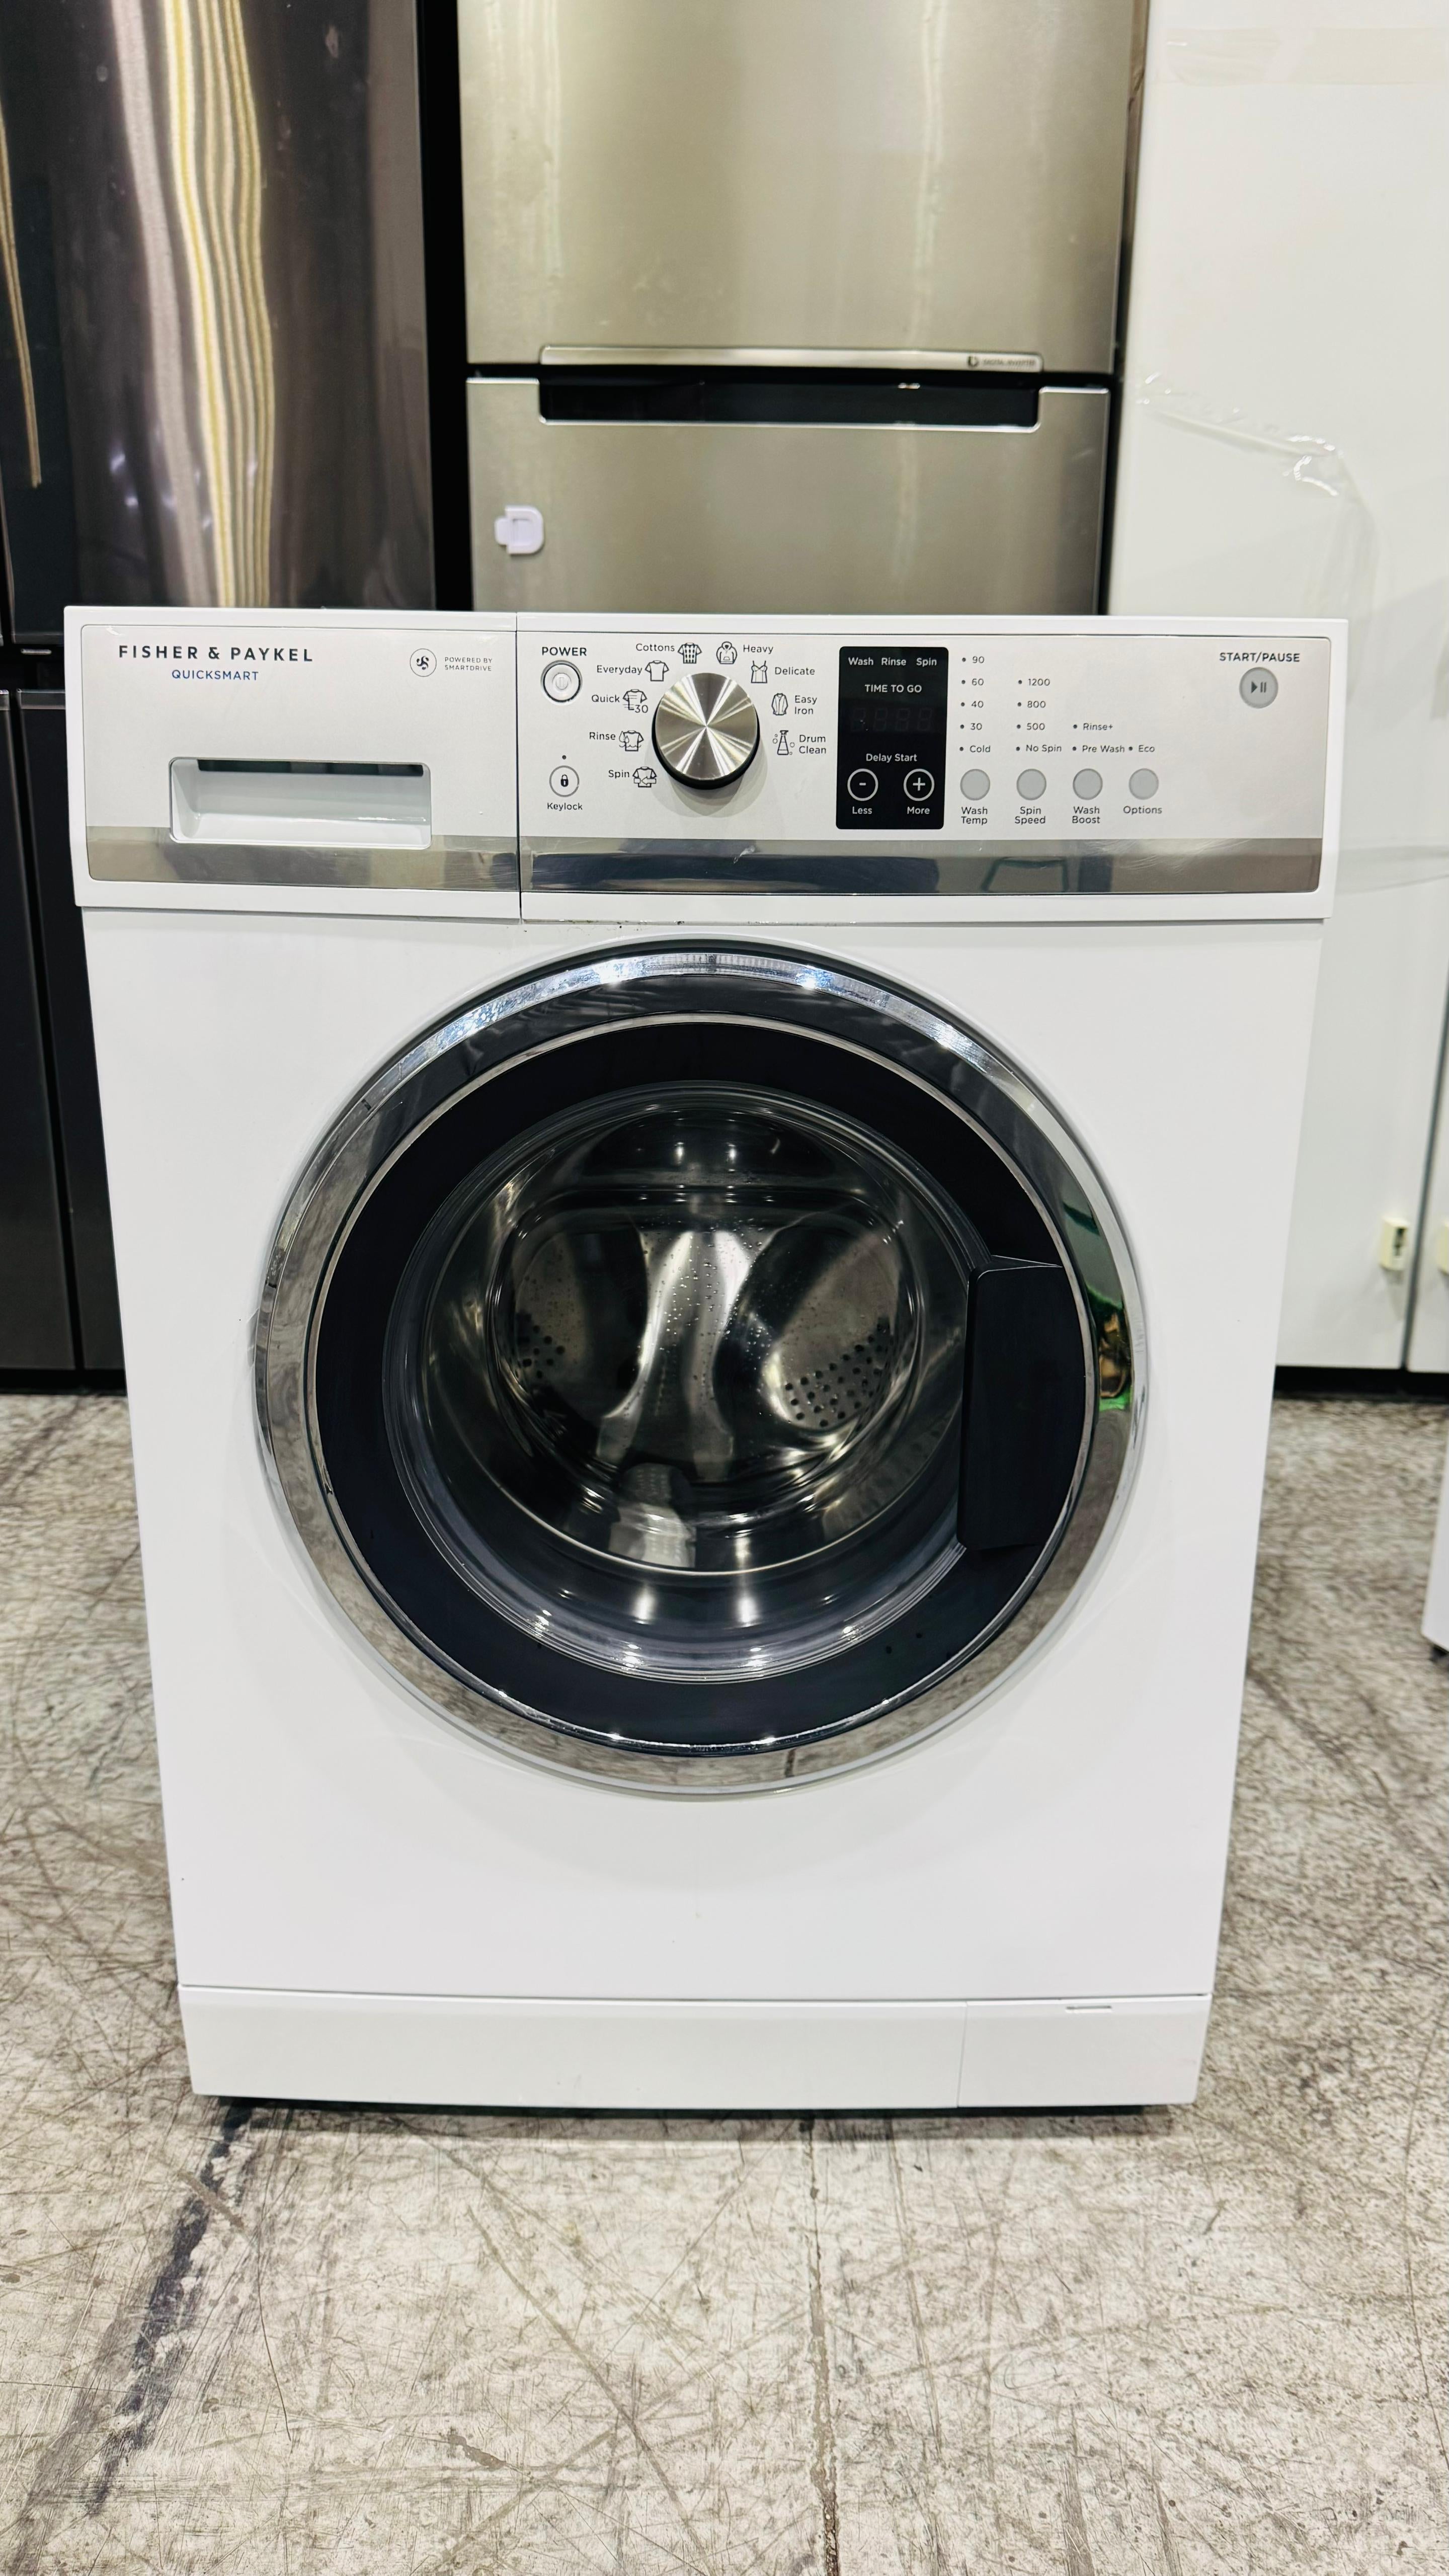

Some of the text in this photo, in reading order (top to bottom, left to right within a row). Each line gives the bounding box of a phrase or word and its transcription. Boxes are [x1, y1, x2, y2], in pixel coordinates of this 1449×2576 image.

[542, 647, 587, 657] POWER
[635, 643, 675, 652] Cottons
[743, 645, 774, 655] Heavy
[119, 645, 312, 662] FISHER & PAYKEL
[1219, 651, 1300, 663] START/PAUSE
[848, 657, 874, 666] Wash
[881, 657, 907, 666] Rinse
[916, 657, 937, 667] Spin
[972, 656, 985, 664] 90
[172, 669, 259, 681] QUICKSMART
[597, 665, 642, 676] Everyday
[775, 666, 815, 675] Delicate
[972, 678, 984, 686] 60
[1028, 678, 1051, 686] 1200
[864, 684, 922, 693] TIME TO GO
[591, 694, 620, 703] Quick
[794, 695, 818, 705] Easy
[634, 704, 649, 713] 30
[971, 700, 984, 708] 40
[1027, 700, 1046, 708] 800
[794, 706, 814, 715] Iron
[970, 722, 983, 731] 30
[1026, 722, 1045, 731] 500
[1083, 722, 1113, 731] Rinse+
[589, 732, 616, 741] Rinse
[799, 734, 826, 743] Drum
[798, 745, 827, 754] Clean
[970, 745, 991, 753] Cold
[1026, 744, 1062, 753] No Spin
[1082, 745, 1125, 753] Pre Wash
[1138, 745, 1155, 753] Eco
[866, 753, 917, 763] Delay Start
[608, 769, 630, 779] Spin
[547, 802, 583, 812] Keylock
[852, 806, 872, 815] Less
[907, 806, 930, 815] More
[961, 807, 988, 815] Wash
[1020, 806, 1041, 816] Spin
[1073, 806, 1100, 815] Wash
[1123, 805, 1162, 816] Options
[960, 816, 988, 826] Temp
[1014, 816, 1046, 826] Speed
[1072, 815, 1100, 824] Boost
